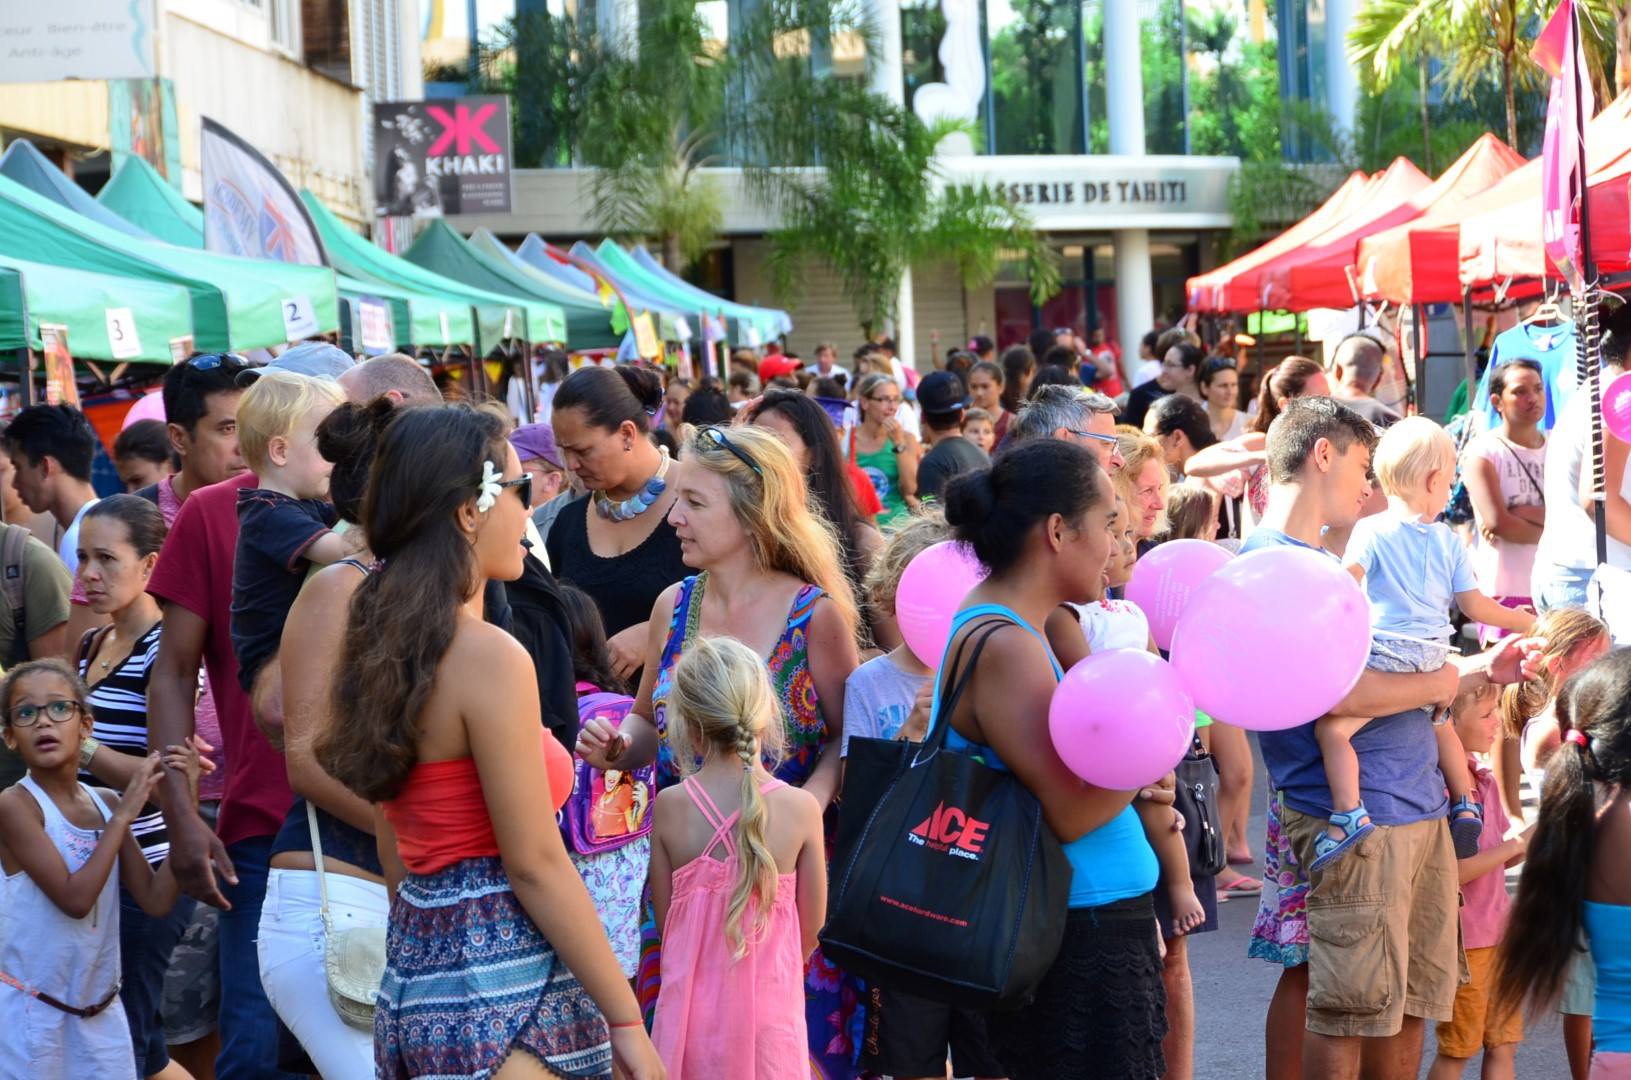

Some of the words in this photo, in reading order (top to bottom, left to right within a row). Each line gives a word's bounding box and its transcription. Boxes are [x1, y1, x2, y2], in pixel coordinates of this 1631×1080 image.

[425, 154, 504, 175] KHAKI
[945, 182, 1075, 204] SSERIE
[1083, 183, 1110, 203] DE
[1117, 181, 1187, 202] TAHITI
[286, 302, 301, 322] 2
[111, 319, 124, 341] 3
[911, 800, 989, 852] ACE
[907, 833, 925, 846] The
[949, 847, 979, 861] place.
